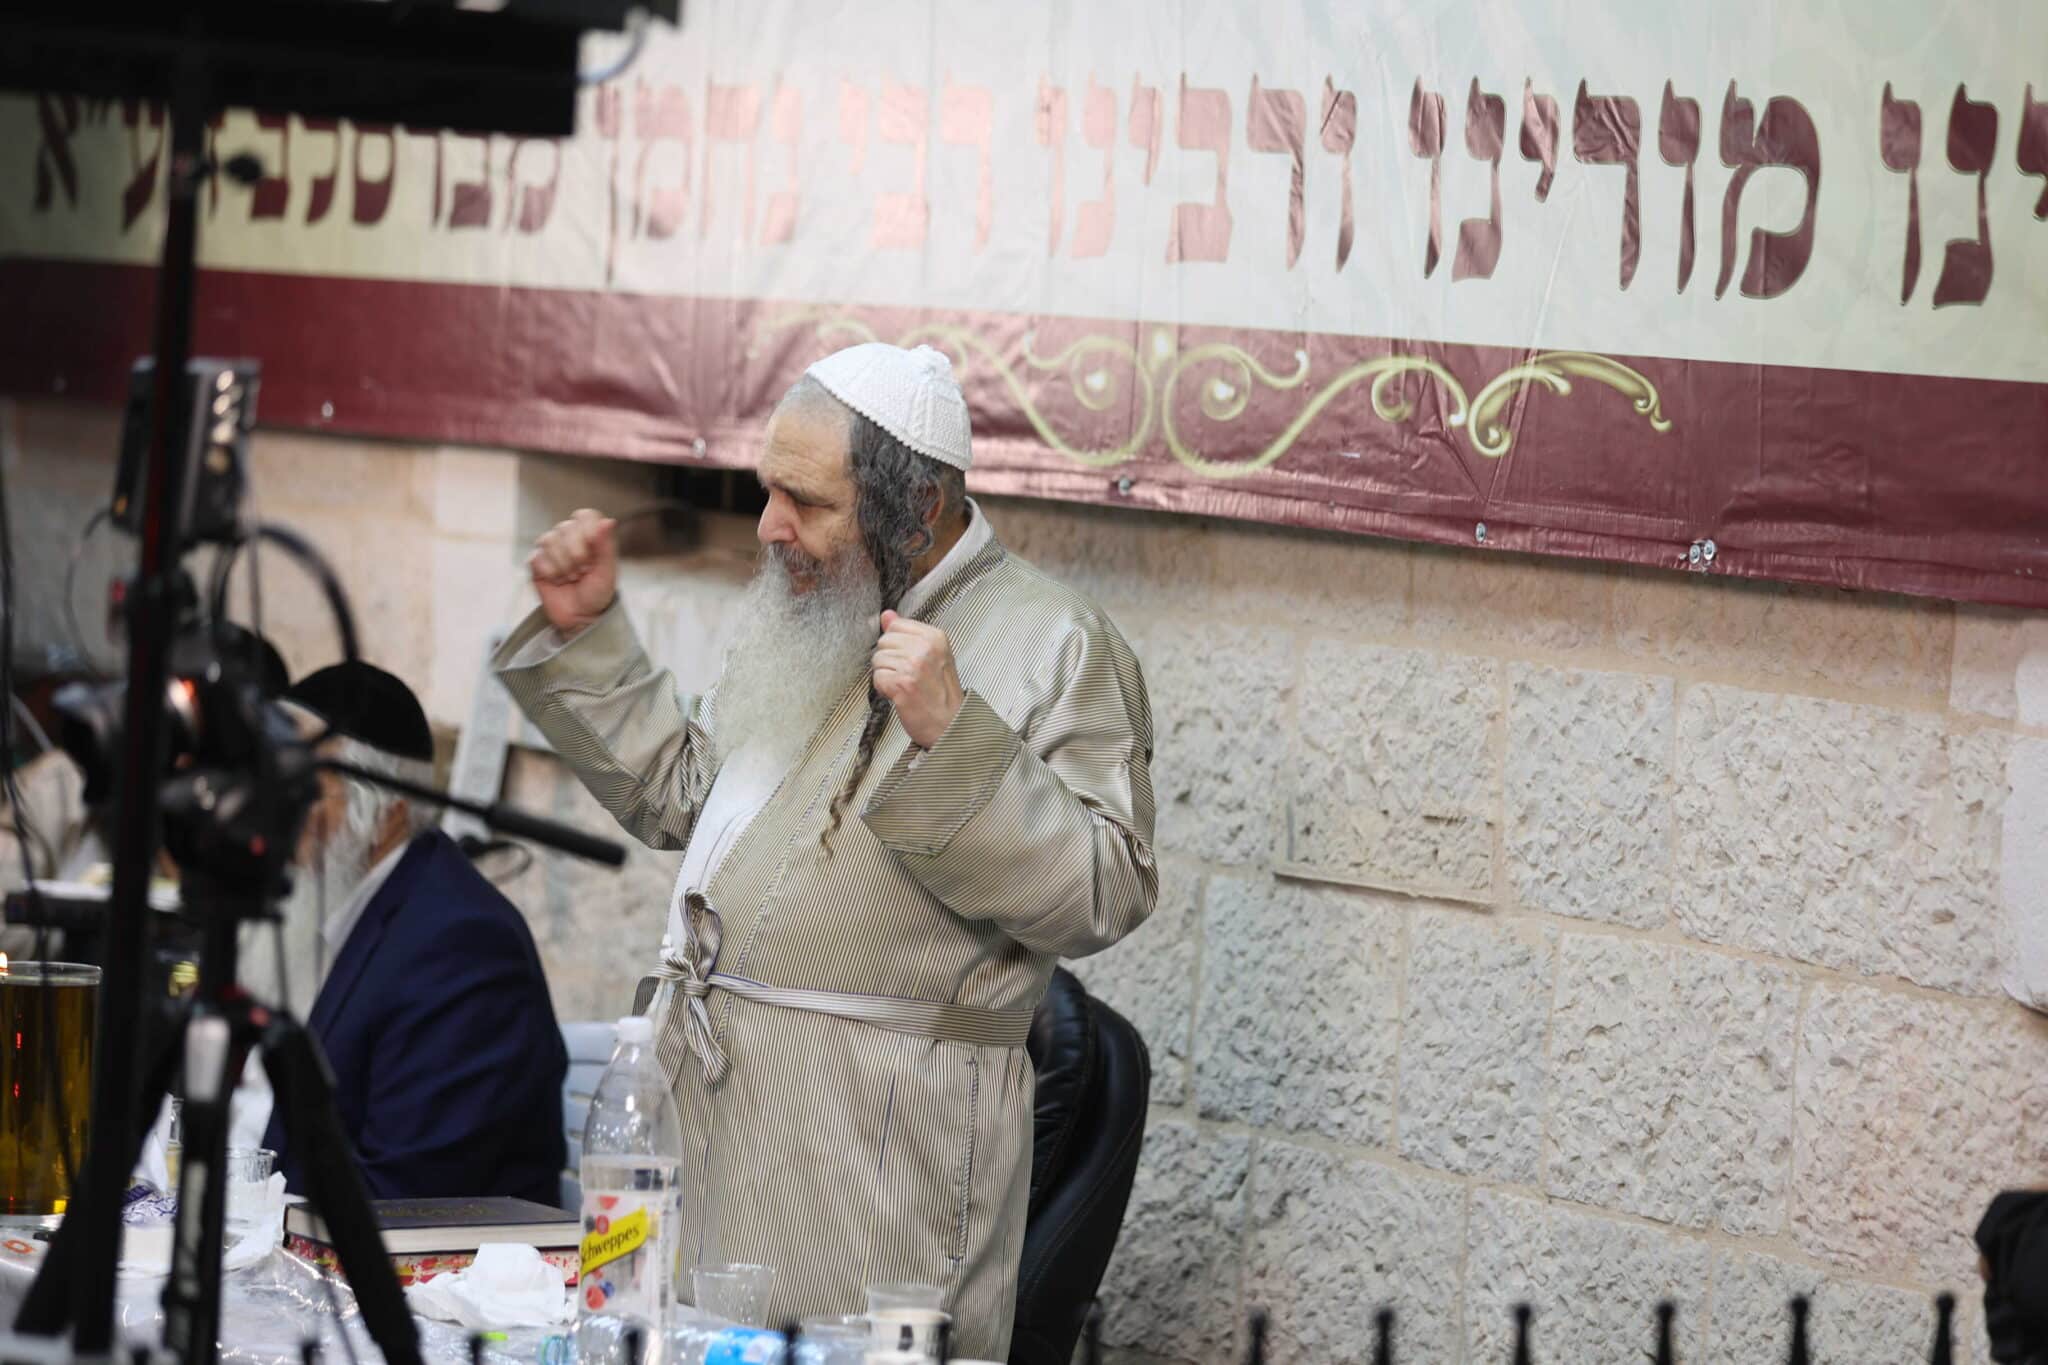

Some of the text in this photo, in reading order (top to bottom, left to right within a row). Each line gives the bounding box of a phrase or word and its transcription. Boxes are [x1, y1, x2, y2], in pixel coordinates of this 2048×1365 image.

[595, 70, 803, 285] נחמן
[838, 70, 993, 256] רבי
[1036, 70, 1357, 274] ורבינו
[1408, 76, 1822, 300] מורינו
